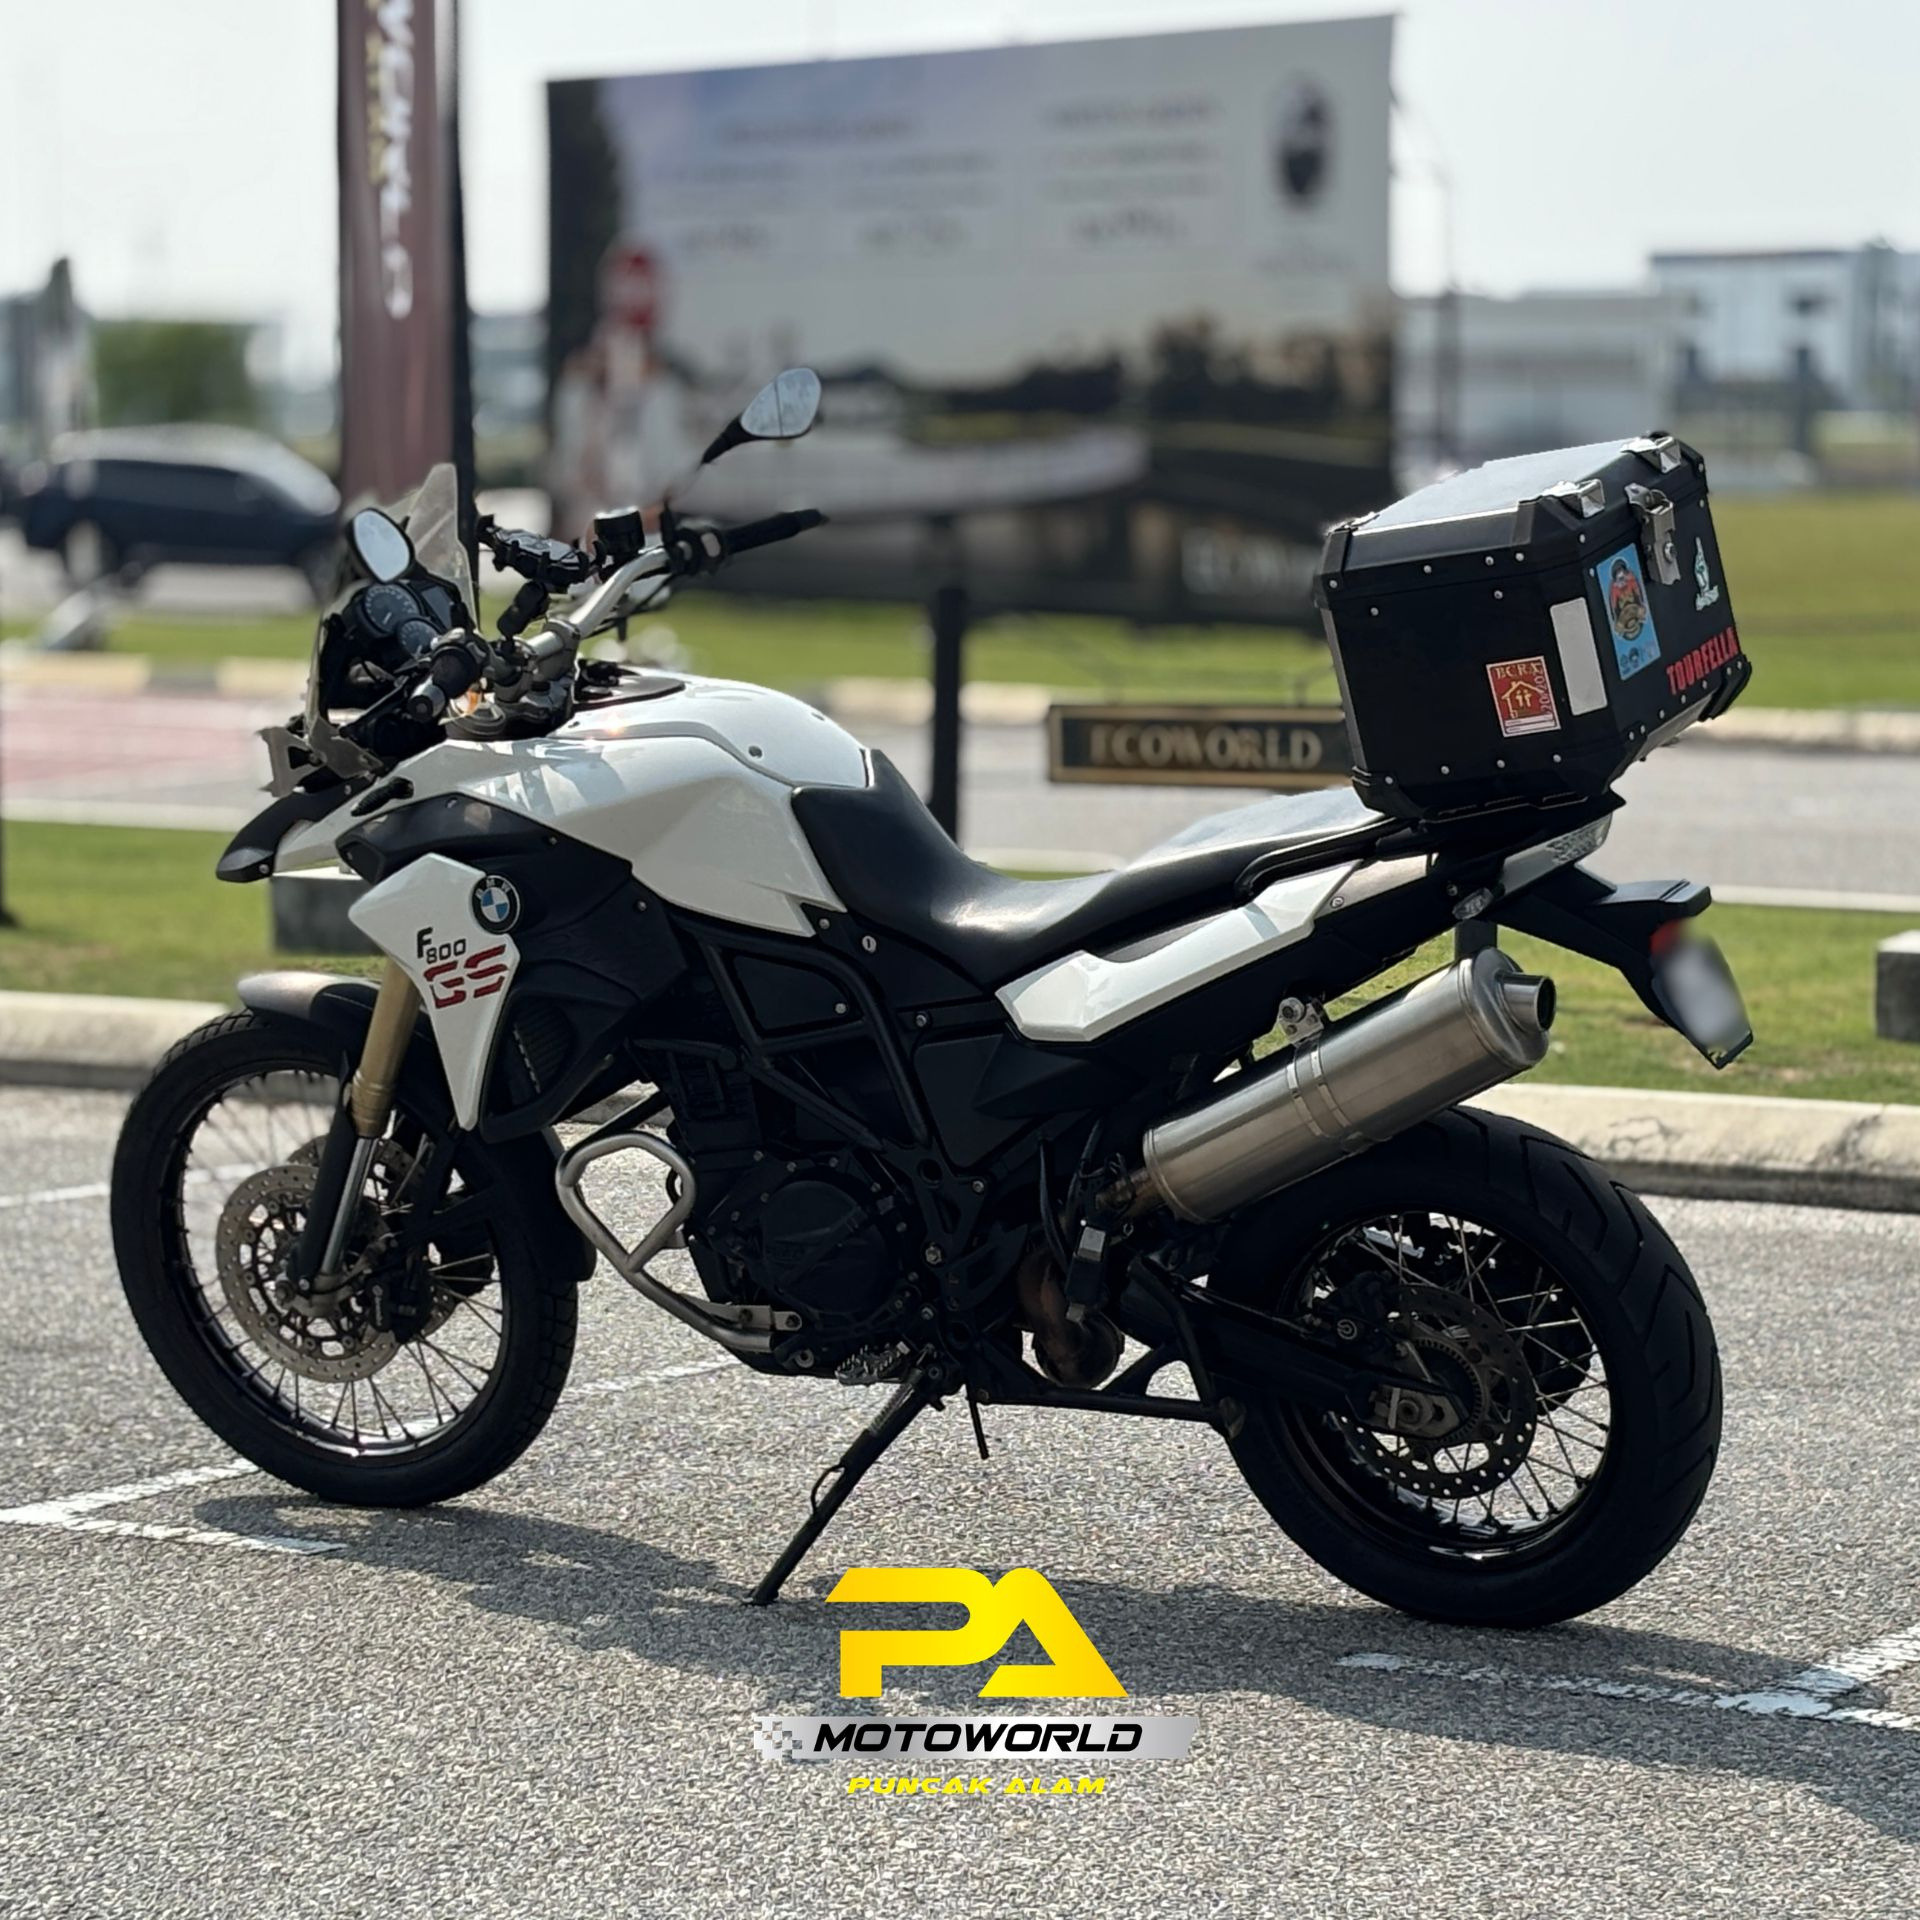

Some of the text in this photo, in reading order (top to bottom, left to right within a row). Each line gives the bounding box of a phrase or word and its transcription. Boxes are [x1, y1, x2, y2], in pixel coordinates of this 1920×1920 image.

[1666, 626, 1738, 695] TOURFELLA
[475, 878, 512, 900] BMW
[423, 944, 507, 1009] GS
